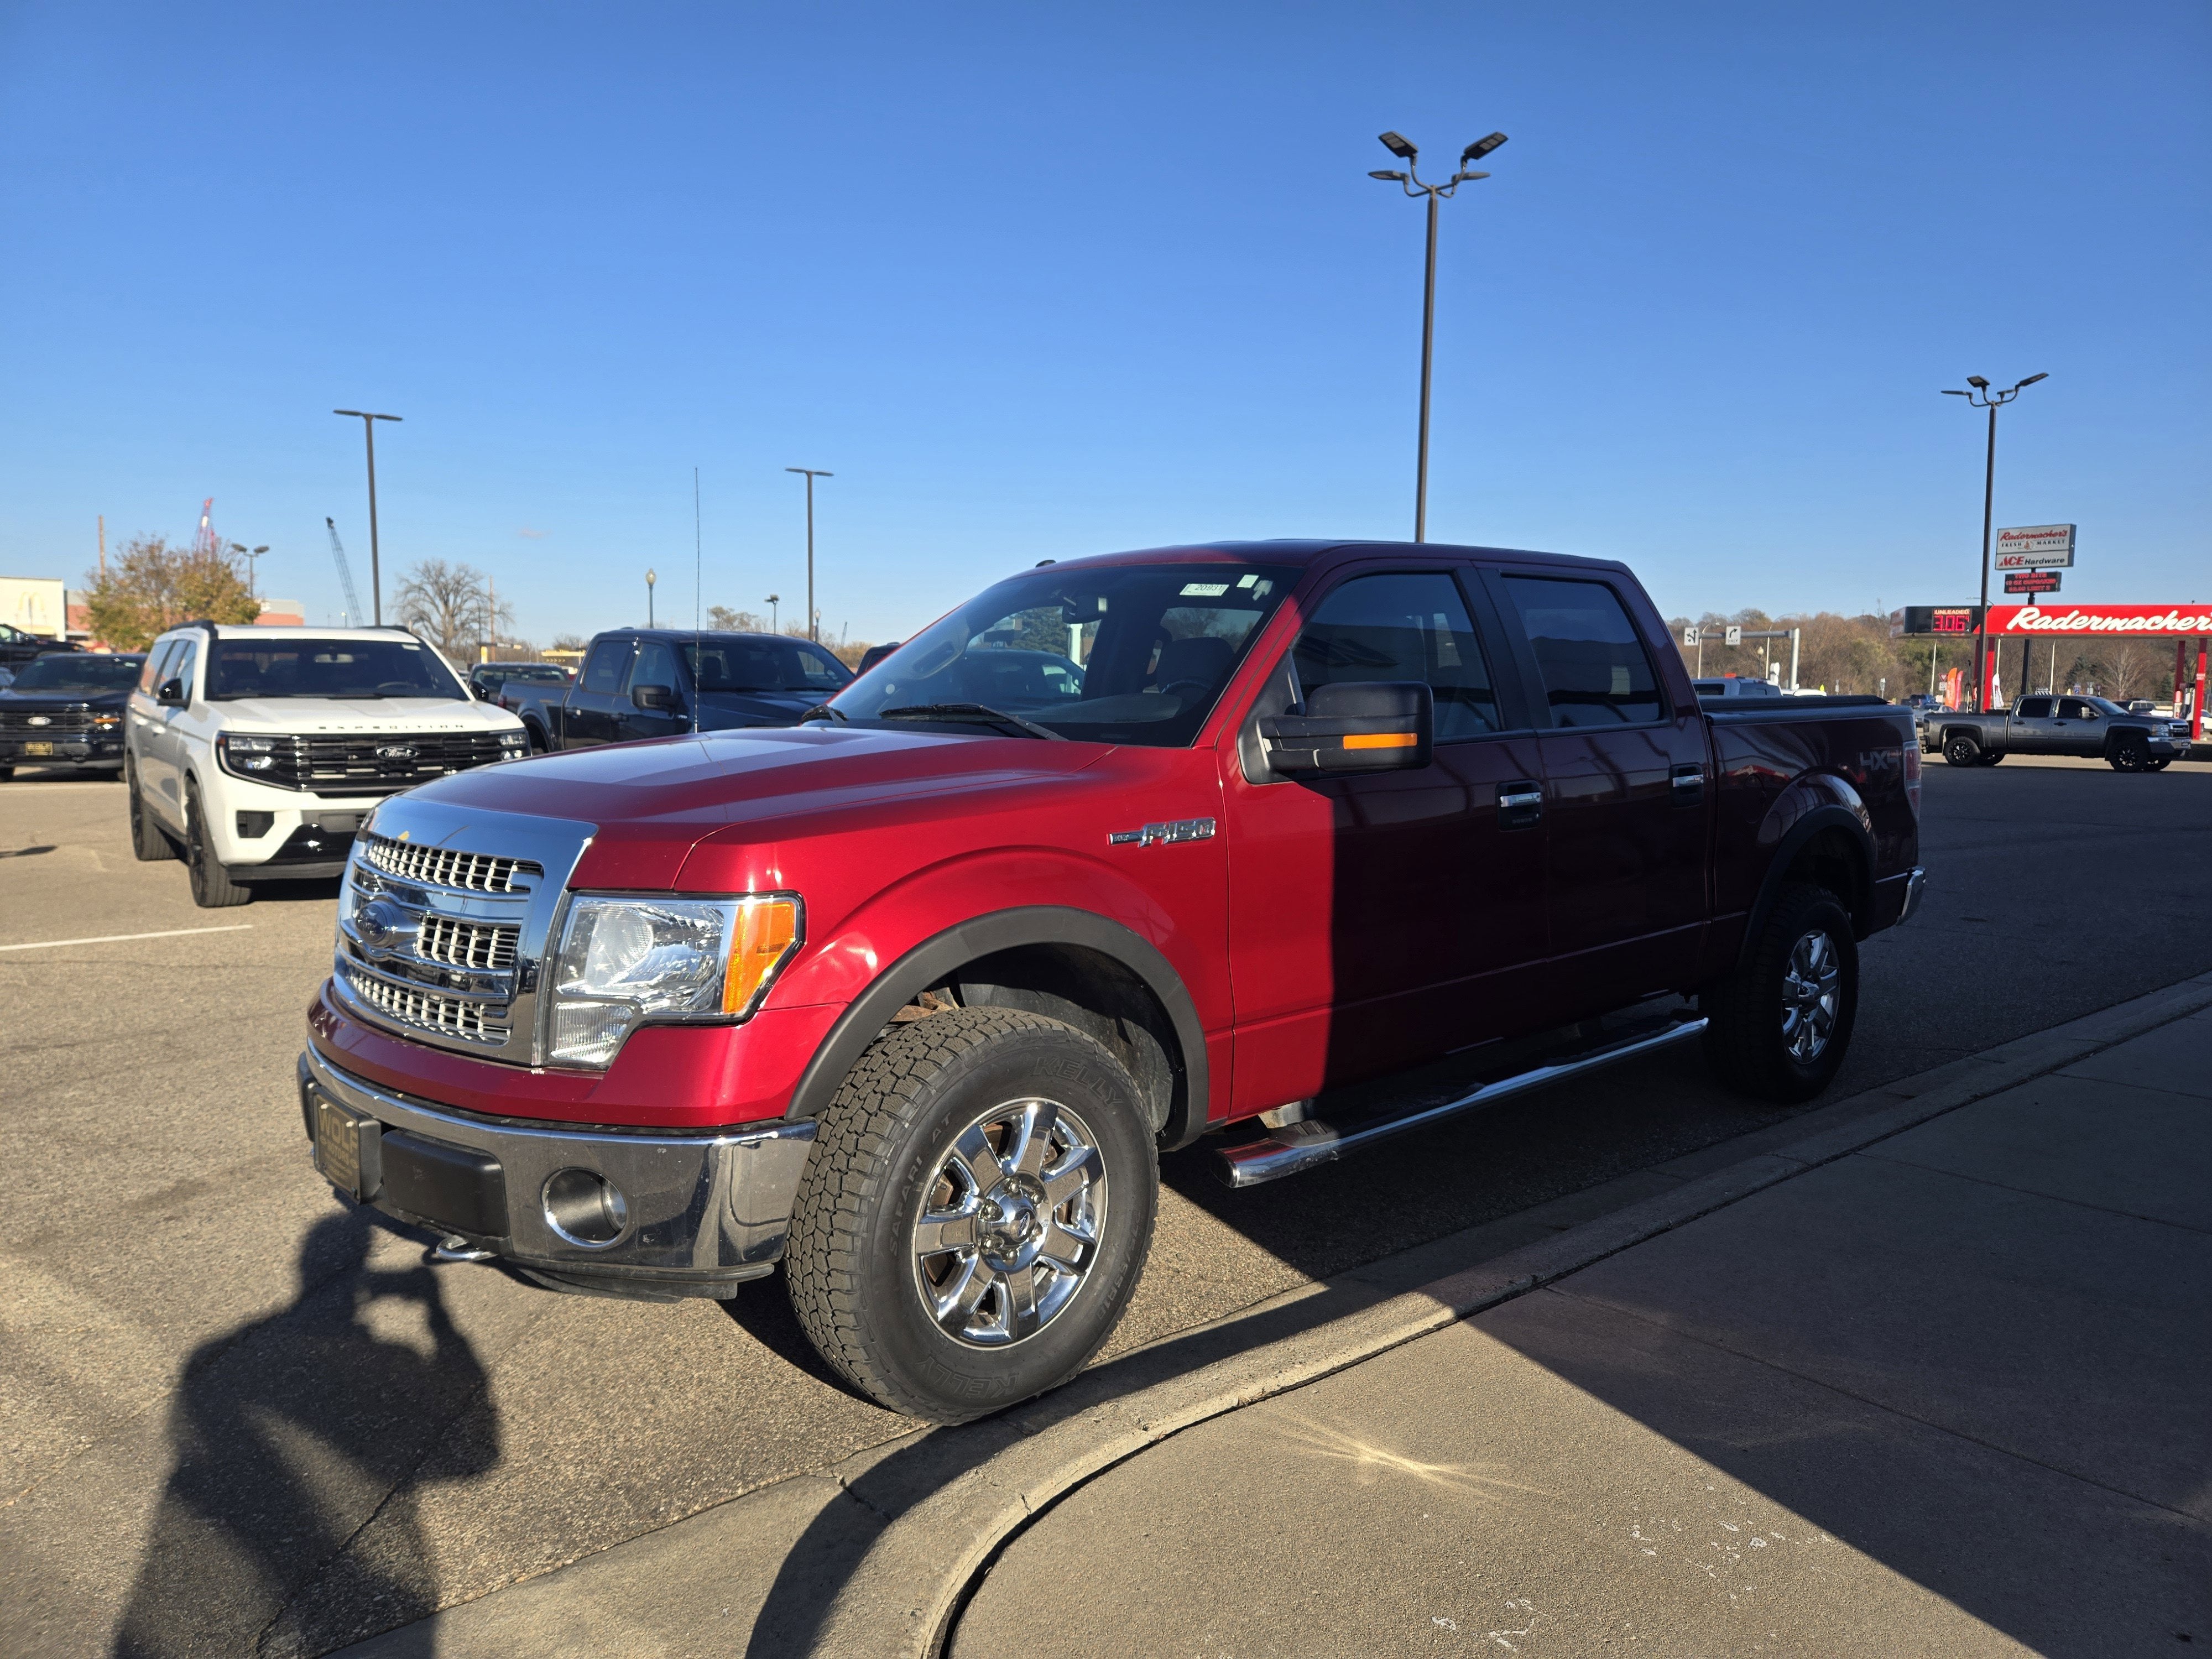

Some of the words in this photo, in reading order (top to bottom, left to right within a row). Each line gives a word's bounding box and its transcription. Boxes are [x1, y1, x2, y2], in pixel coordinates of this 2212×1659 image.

[2000, 529, 2068, 541] Radermacher's
[1999, 556, 2025, 566] ACE
[1031, 1056, 1123, 1107] KELLY
[318, 1106, 358, 1154] WOLF
[889, 1156, 923, 1257] SAFARI
[932, 1112, 952, 1145] AT
[914, 1356, 1018, 1400] KELLY
